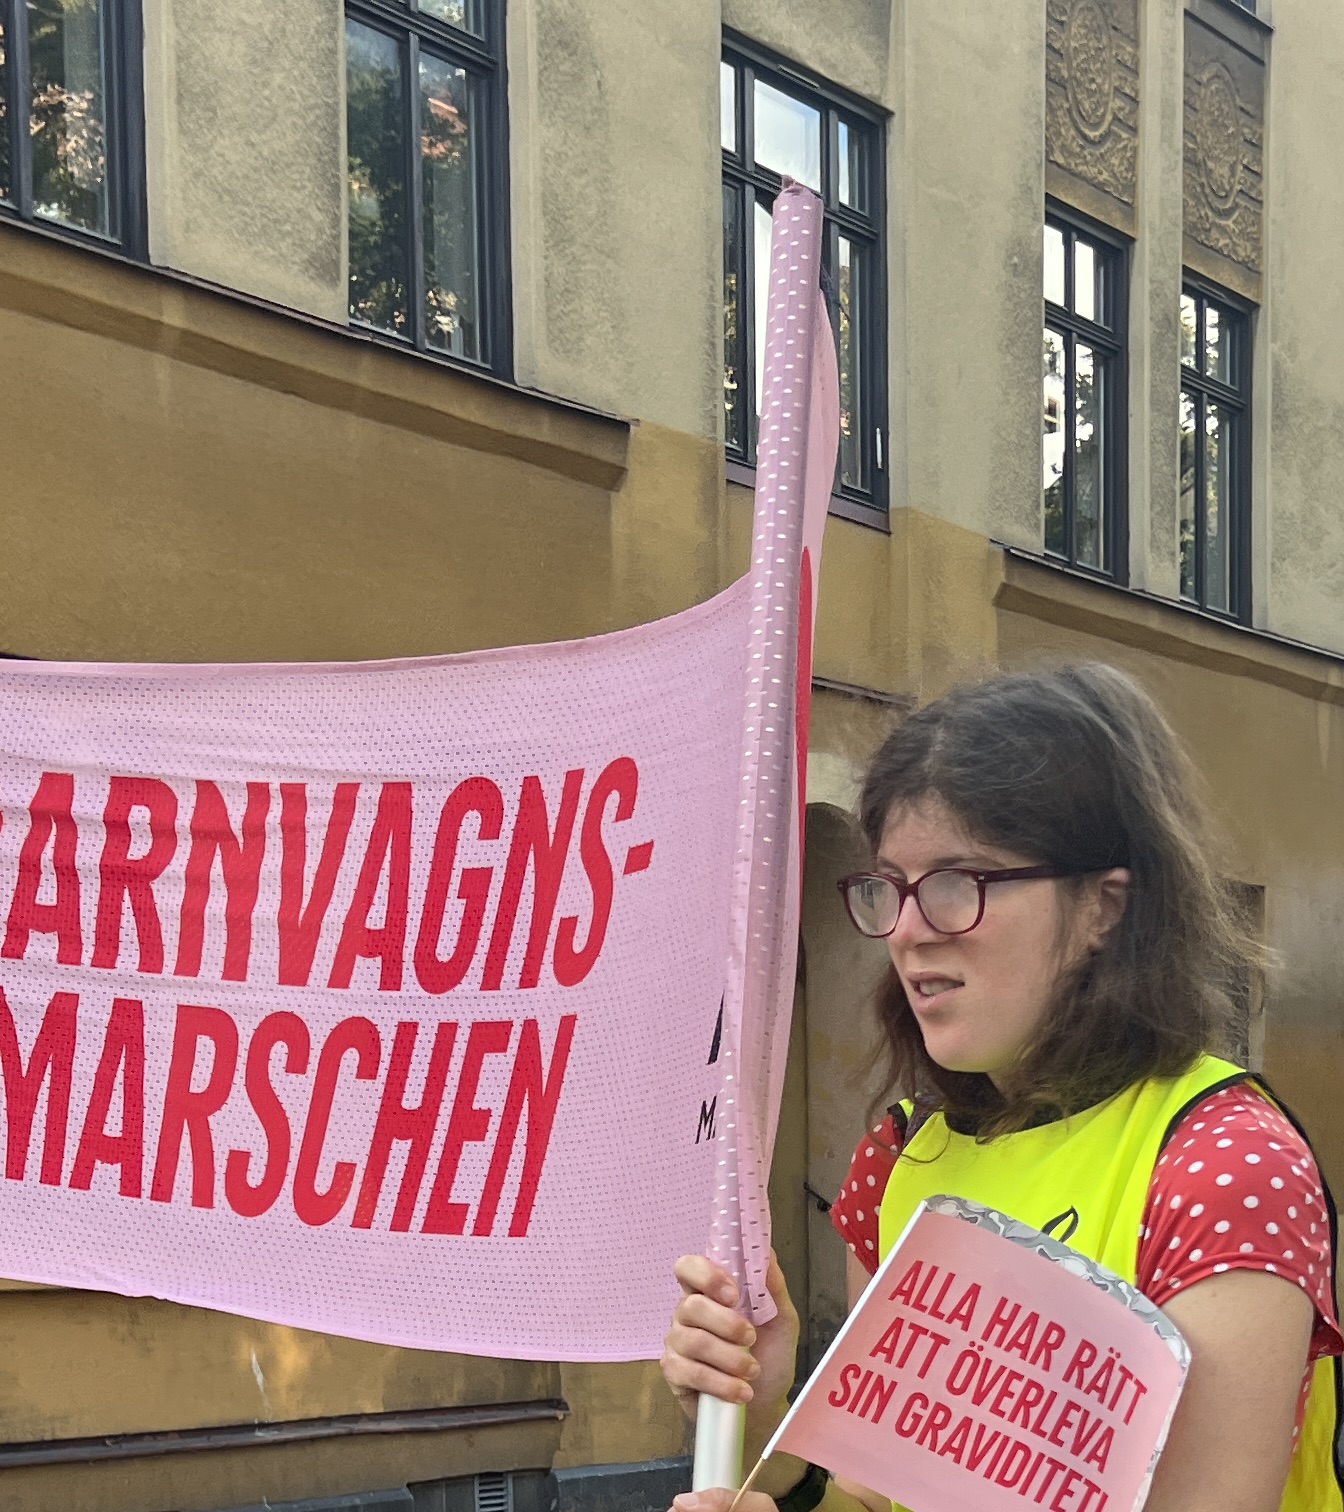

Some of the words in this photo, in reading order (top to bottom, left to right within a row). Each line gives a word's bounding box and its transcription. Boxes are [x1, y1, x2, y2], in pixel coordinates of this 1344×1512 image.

[828, 1363, 898, 1425] SIN
[869, 1316, 951, 1379] ATT
[945, 1343, 1115, 1474] ÖVERLEVA
[888, 1260, 982, 1331] ALLA
[980, 1296, 1066, 1371] HAR
[1062, 1337, 1148, 1426] RÄTT
